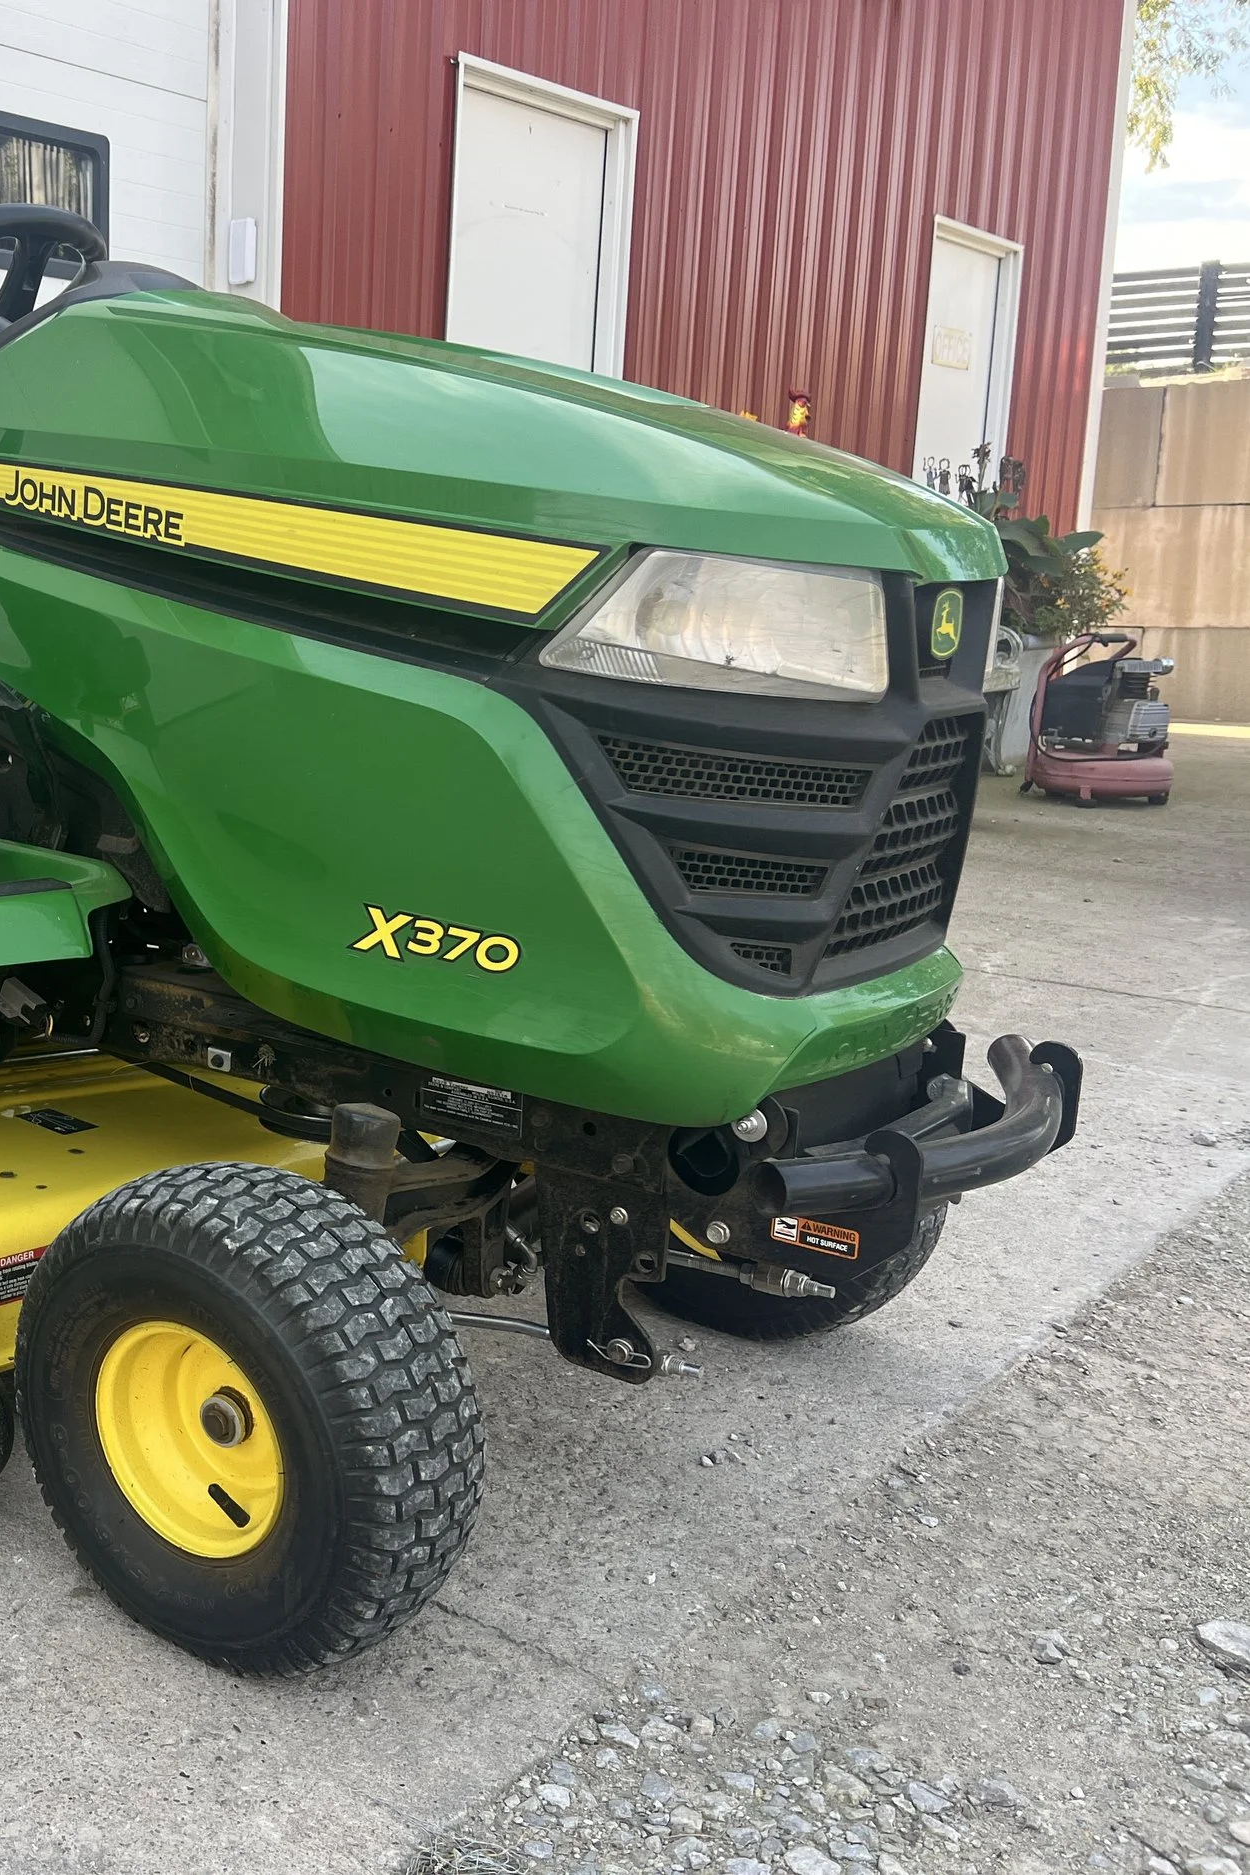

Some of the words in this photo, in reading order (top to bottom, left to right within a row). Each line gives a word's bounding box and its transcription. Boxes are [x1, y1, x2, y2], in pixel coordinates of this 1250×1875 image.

[935, 330, 969, 365] OFFICE
[5, 470, 76, 517] JOHN
[83, 486, 184, 542] DEERE
[349, 903, 522, 974] X370
[806, 1235, 819, 1245] HOT
[820, 1239, 849, 1252] SURFACE
[812, 1222, 856, 1242] WARNING
[0, 1250, 34, 1267] DANGER
